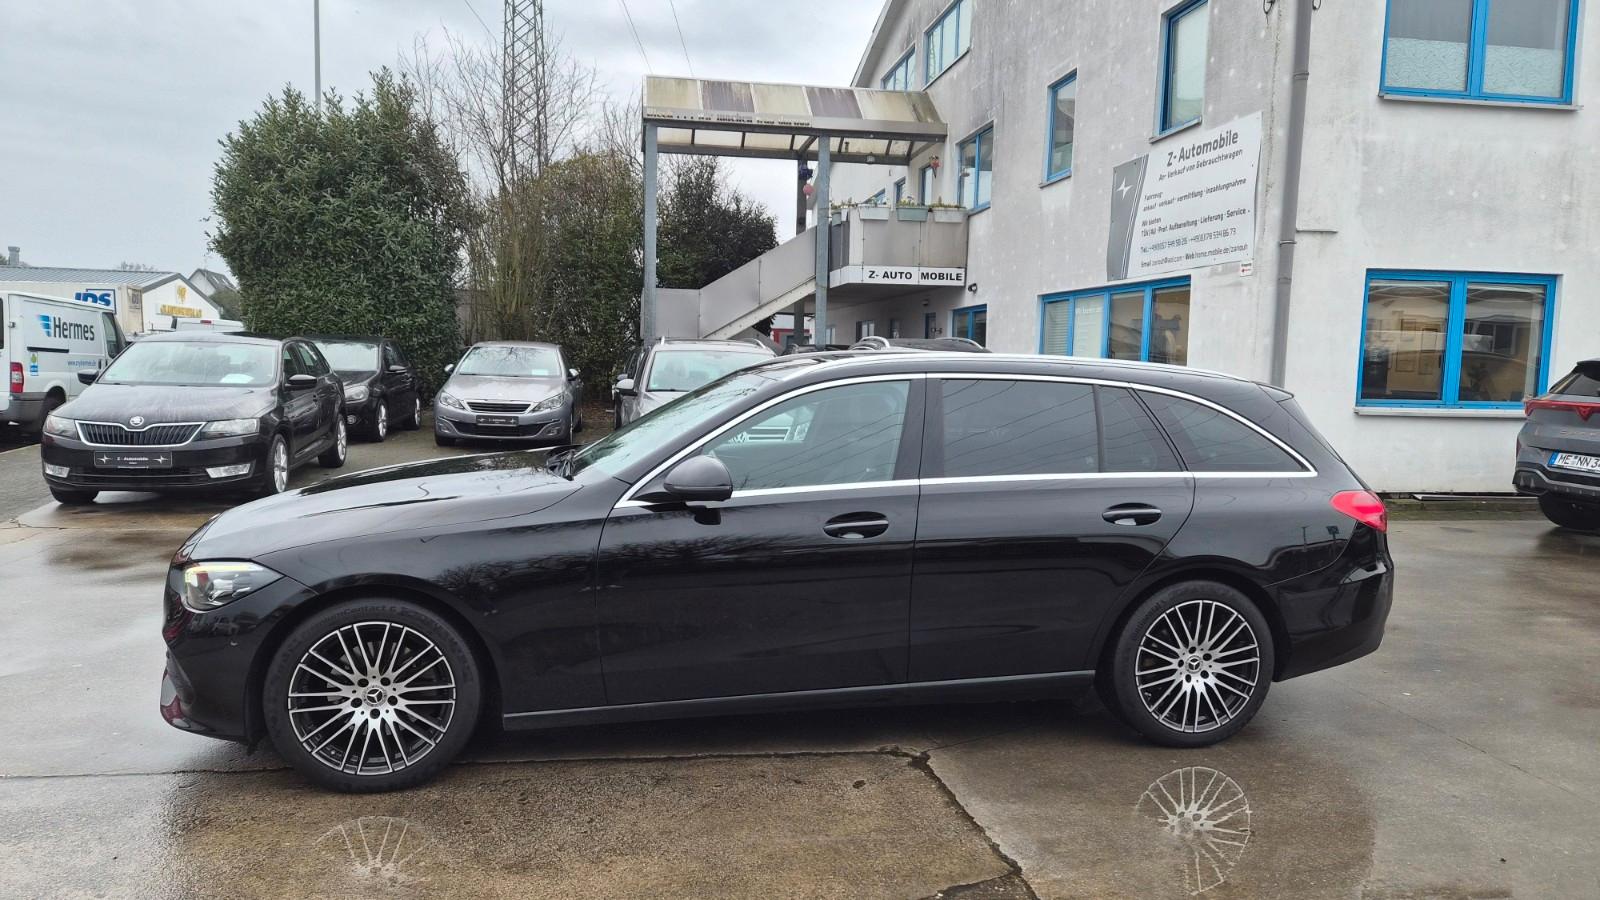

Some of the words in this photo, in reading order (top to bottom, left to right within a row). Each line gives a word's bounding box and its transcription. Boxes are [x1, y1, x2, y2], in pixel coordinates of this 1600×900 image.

[1178, 129, 1239, 163] Automobile
[1200, 213, 1224, 224] Lieferung
[1226, 208, 1246, 218] Service
[882, 271, 912, 280] AUTO
[920, 272, 963, 281] MOBILE
[53, 316, 95, 341] Hermes
[1576, 456, 1592, 466] NN
